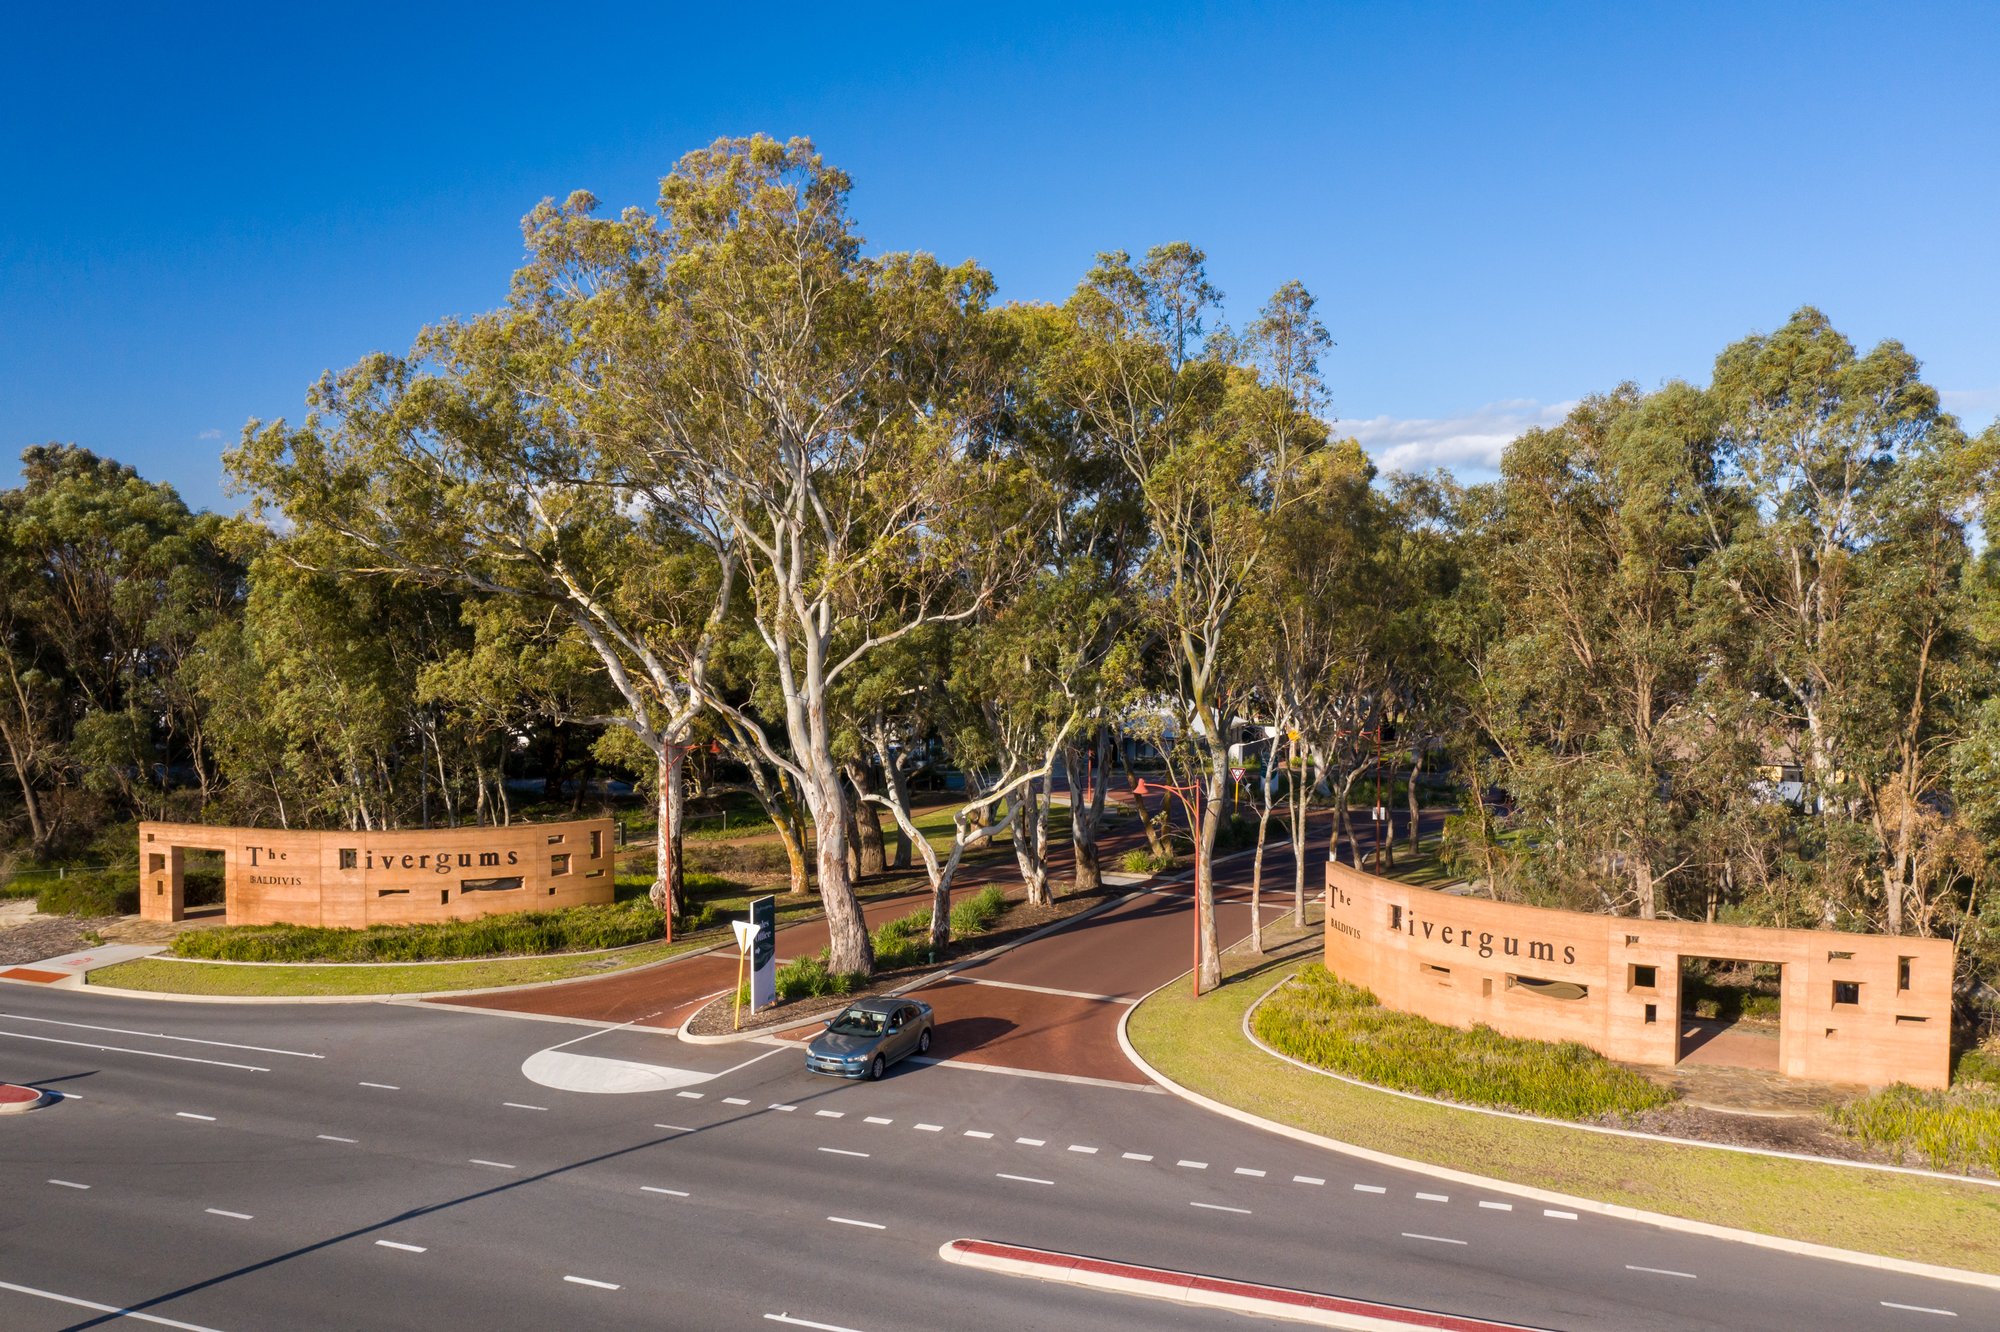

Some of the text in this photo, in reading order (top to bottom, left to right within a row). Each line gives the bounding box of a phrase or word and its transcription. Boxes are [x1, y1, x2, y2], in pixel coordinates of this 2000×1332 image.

[246, 846, 519, 874] The Rivergums
[250, 875, 302, 886] BALDIVIS
[1328, 883, 1576, 965] The Rivergums
[1331, 917, 1361, 940] BALDIVIS
